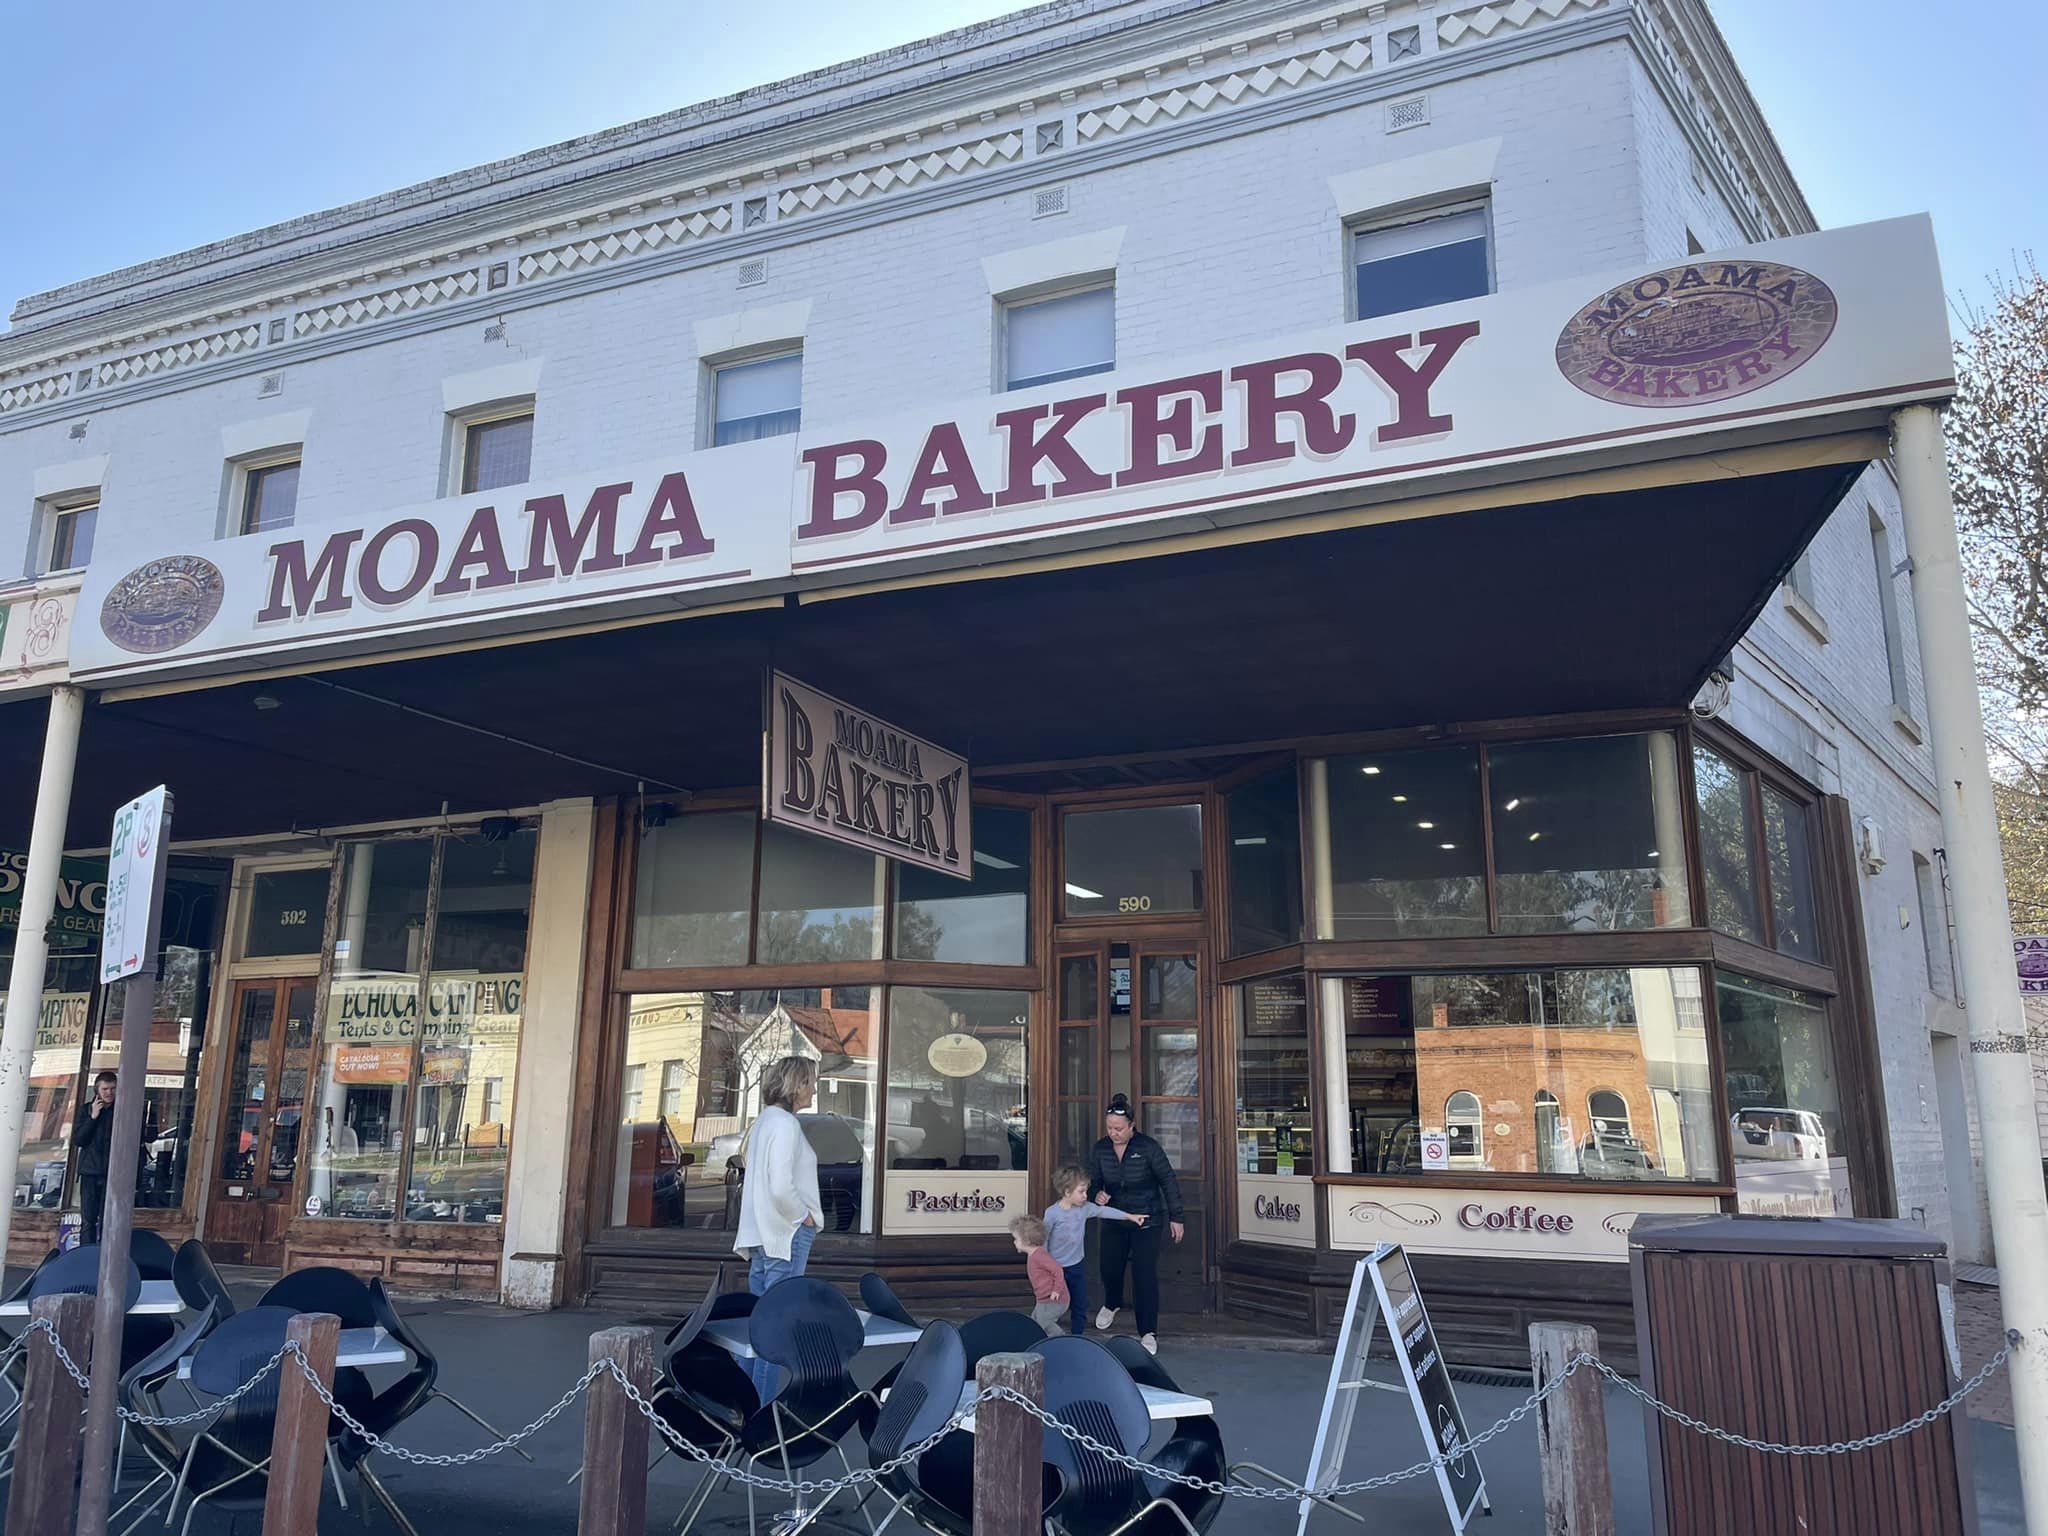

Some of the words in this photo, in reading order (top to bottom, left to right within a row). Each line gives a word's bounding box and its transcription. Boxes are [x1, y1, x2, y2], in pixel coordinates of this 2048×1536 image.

[1585, 263, 1798, 332] MOAMA
[1591, 324, 1799, 398] BAKERY
[258, 471, 716, 625] MOAMA
[796, 321, 1481, 541] BAKERY
[833, 708, 924, 782] MOAMA
[782, 686, 962, 863] BAKERY
[113, 811, 133, 859] 2P
[1118, 895, 1151, 913] 590
[340, 985, 417, 1020] ECHUCA
[38, 1029, 79, 1047] Tackle
[338, 1018, 378, 1040] Tents
[382, 1020, 394, 1036] &
[398, 1018, 471, 1041] Cmping
[339, 1063, 355, 1072] OUT
[906, 1187, 1007, 1213] Pastries
[1254, 1193, 1302, 1222] Cakes
[1457, 1201, 1576, 1235] Coffee
